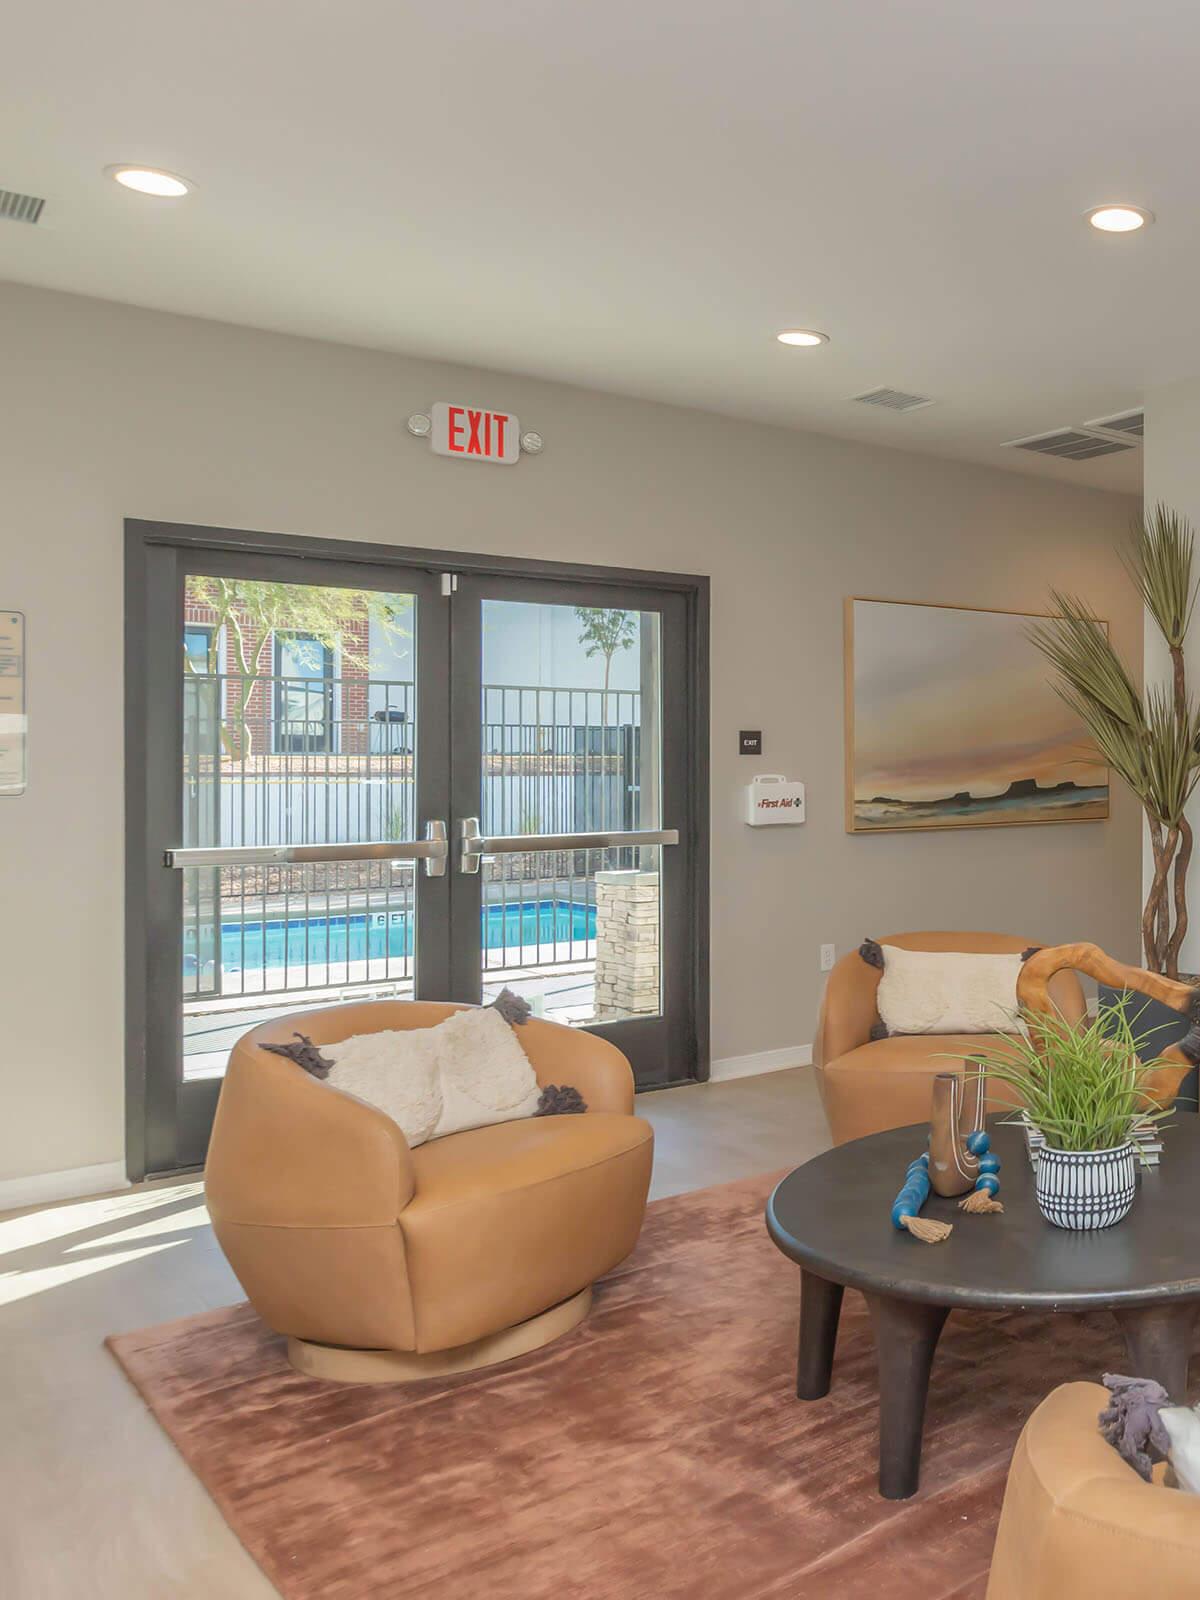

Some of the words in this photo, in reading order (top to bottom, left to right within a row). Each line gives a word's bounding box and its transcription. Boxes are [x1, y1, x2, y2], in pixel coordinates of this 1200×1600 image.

[448, 406, 509, 458] EXIT
[761, 799, 779, 809] First
[779, 797, 793, 808] Aid
